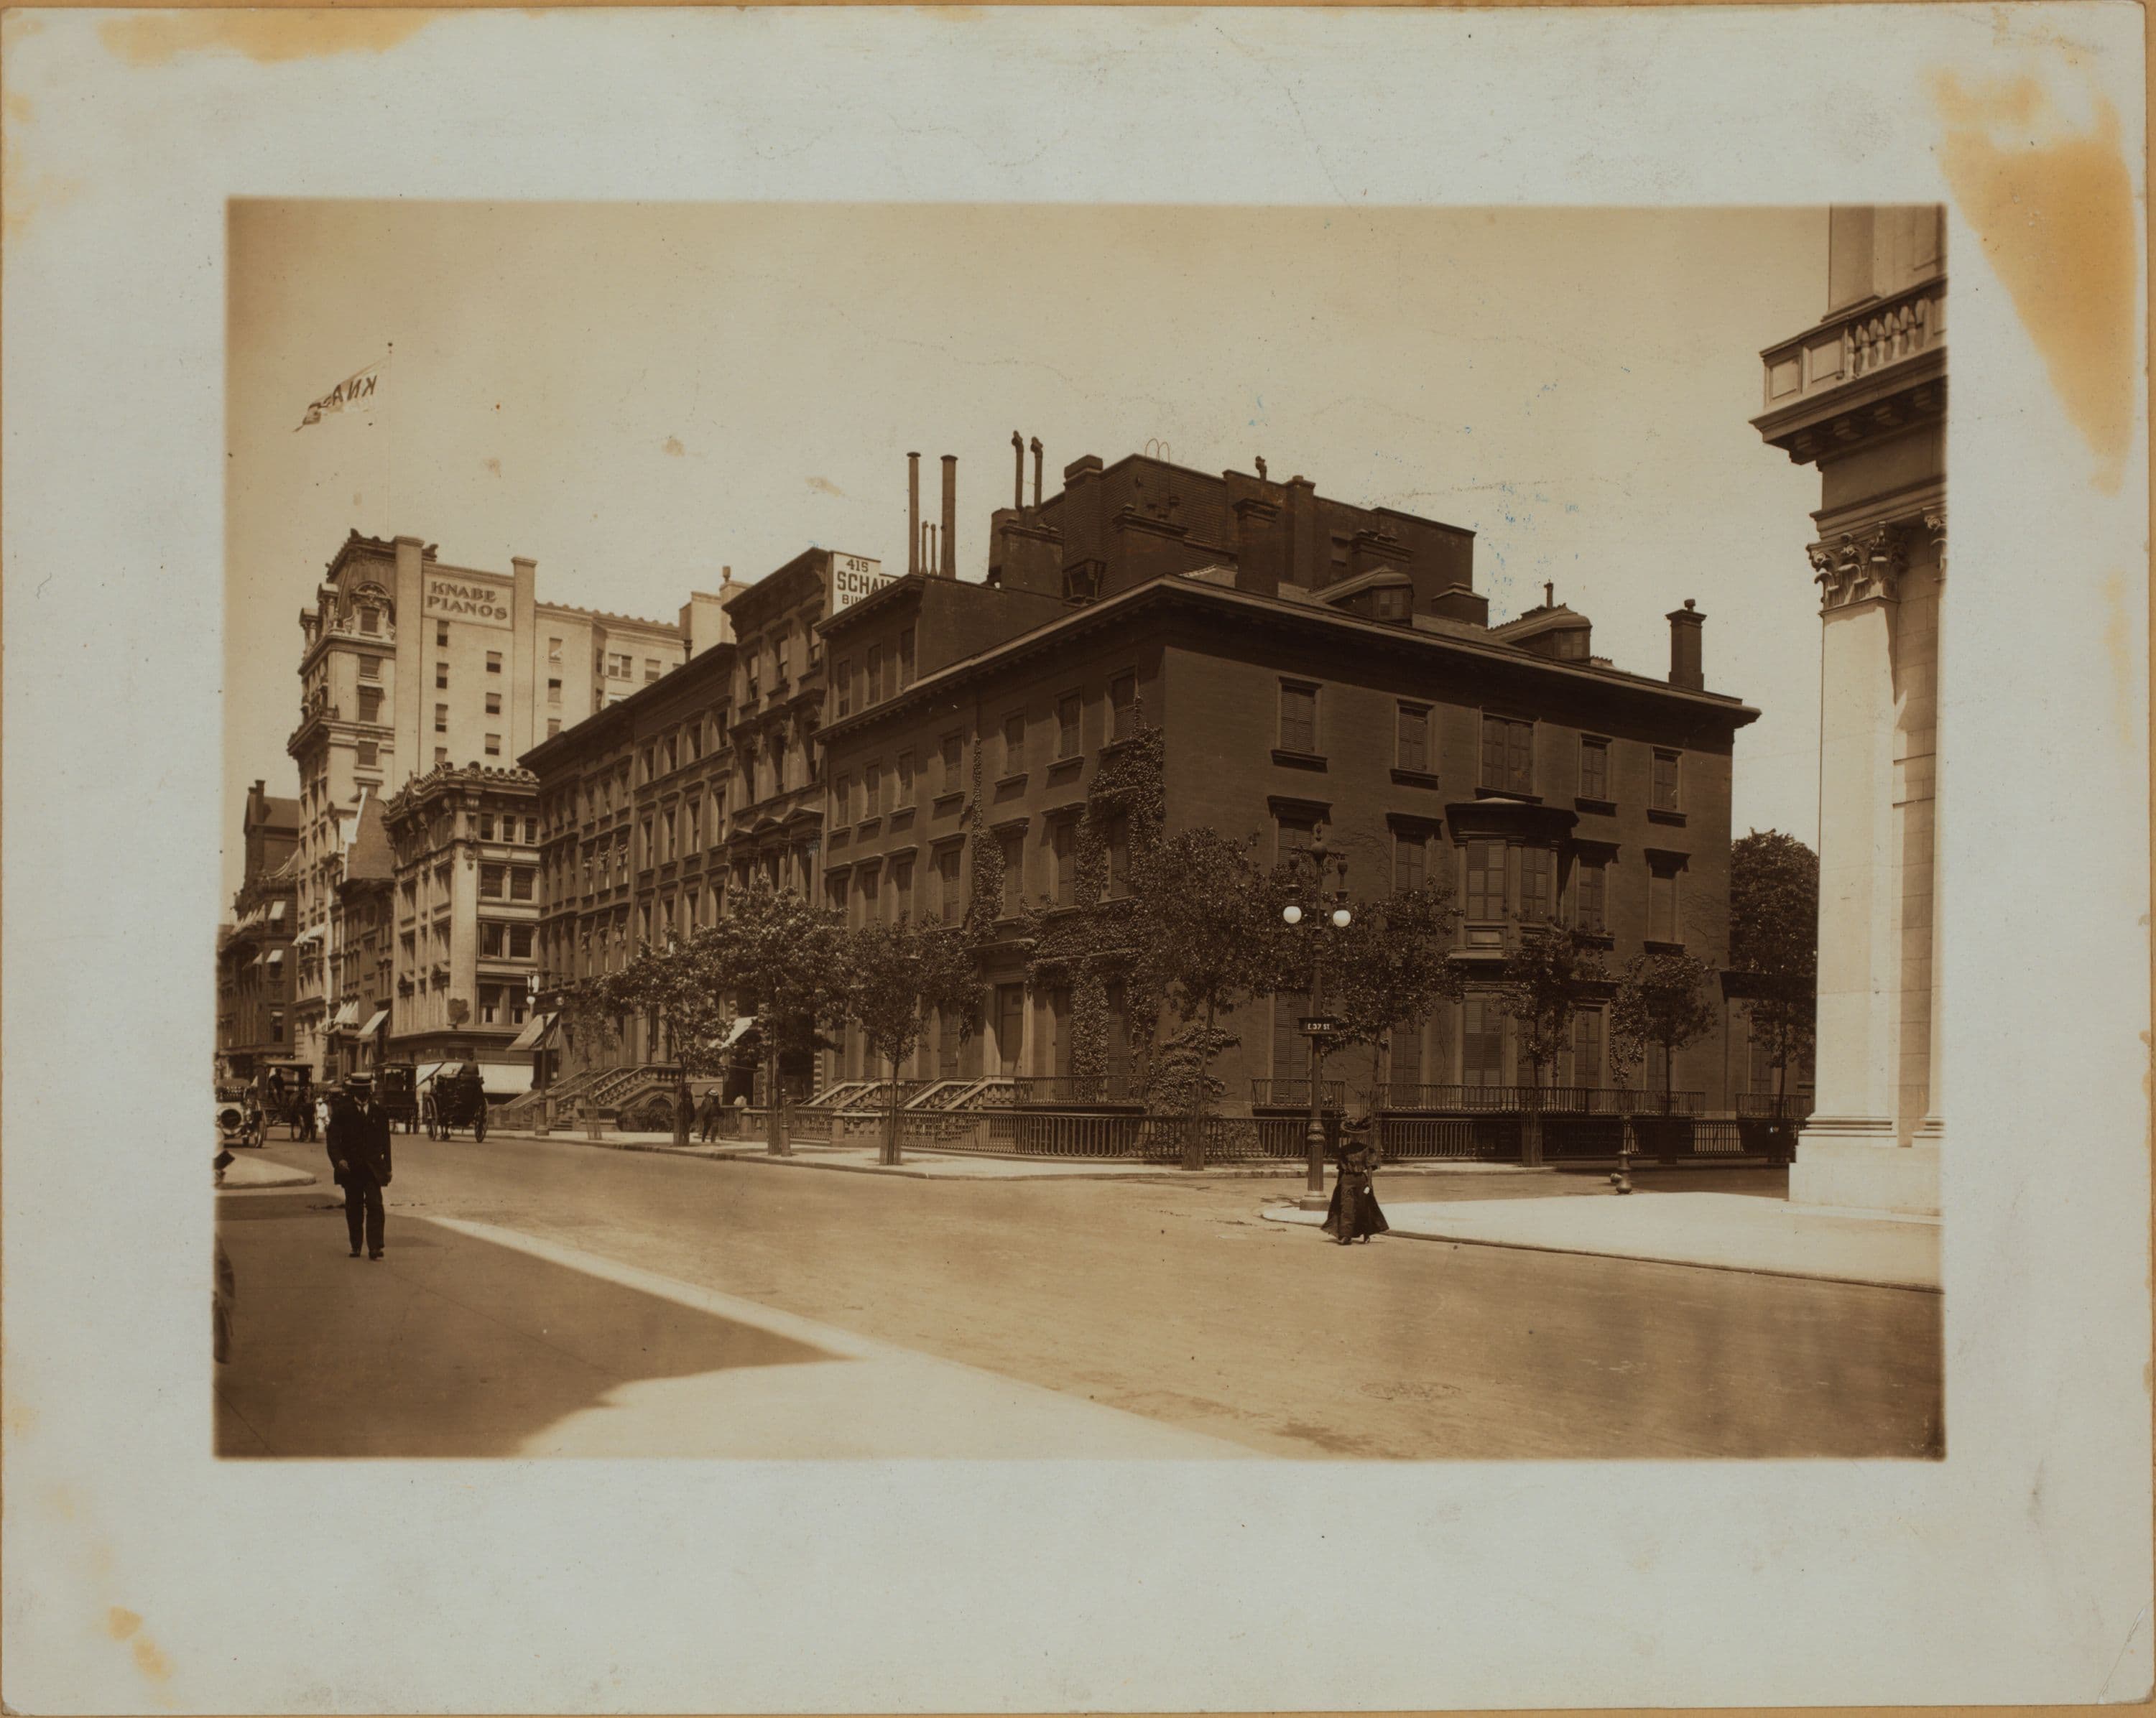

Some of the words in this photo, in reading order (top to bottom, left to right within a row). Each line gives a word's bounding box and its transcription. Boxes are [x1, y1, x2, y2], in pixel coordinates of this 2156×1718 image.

[846, 558, 869, 572] 415
[430, 581, 496, 603] KNABE
[426, 595, 507, 621] PIANOS
